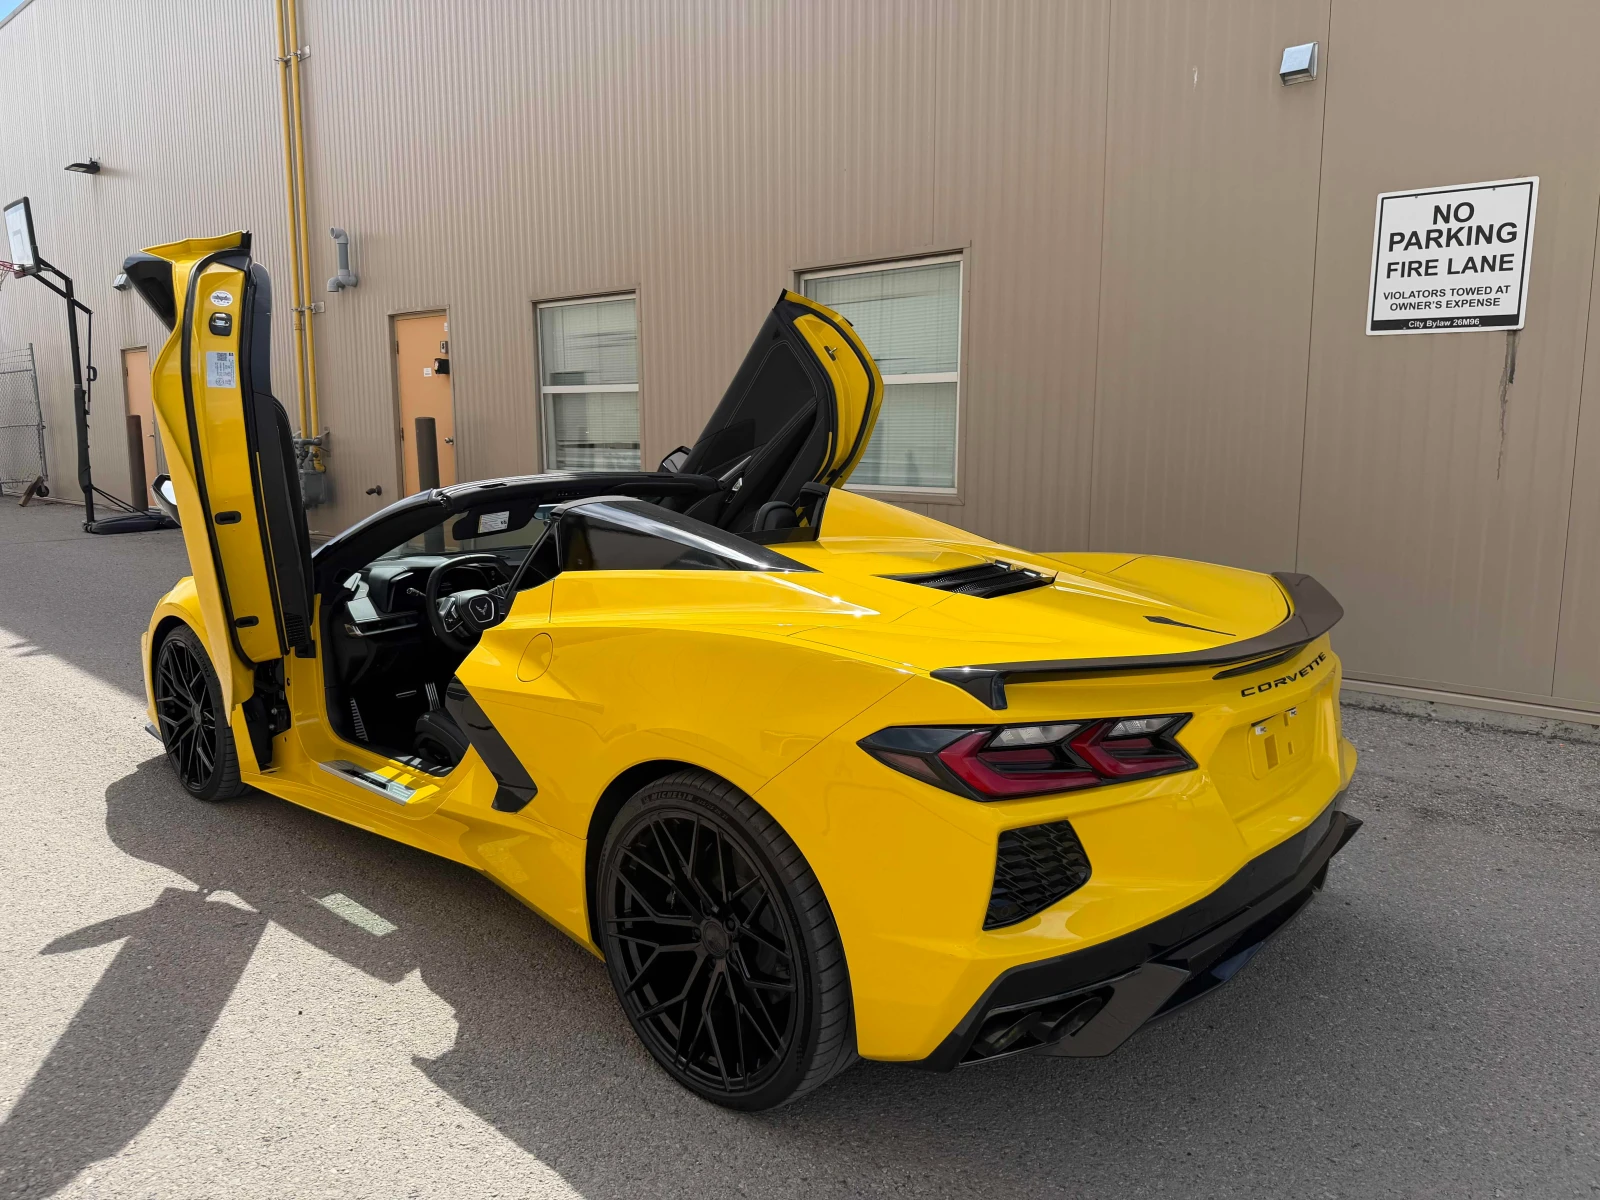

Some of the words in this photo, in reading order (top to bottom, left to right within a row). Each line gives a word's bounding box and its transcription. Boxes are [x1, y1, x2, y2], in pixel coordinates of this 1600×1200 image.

[1432, 201, 1475, 225] NO
[1388, 222, 1518, 252] PARKING
[1386, 259, 1439, 279] FIRE
[1446, 253, 1515, 275] LANE
[1383, 288, 1446, 300] VIOLATORS
[1449, 286, 1493, 297] TOWED
[1495, 285, 1511, 294] AT
[1389, 300, 1442, 311] OWNER'S
[1445, 297, 1501, 309] EXPENSE
[1408, 319, 1425, 329] City
[1426, 319, 1451, 328] Bylaw
[1453, 318, 1480, 326] 26M96
[1241, 651, 1327, 697] CORVETTE
[651, 791, 694, 801] MICHELIN
